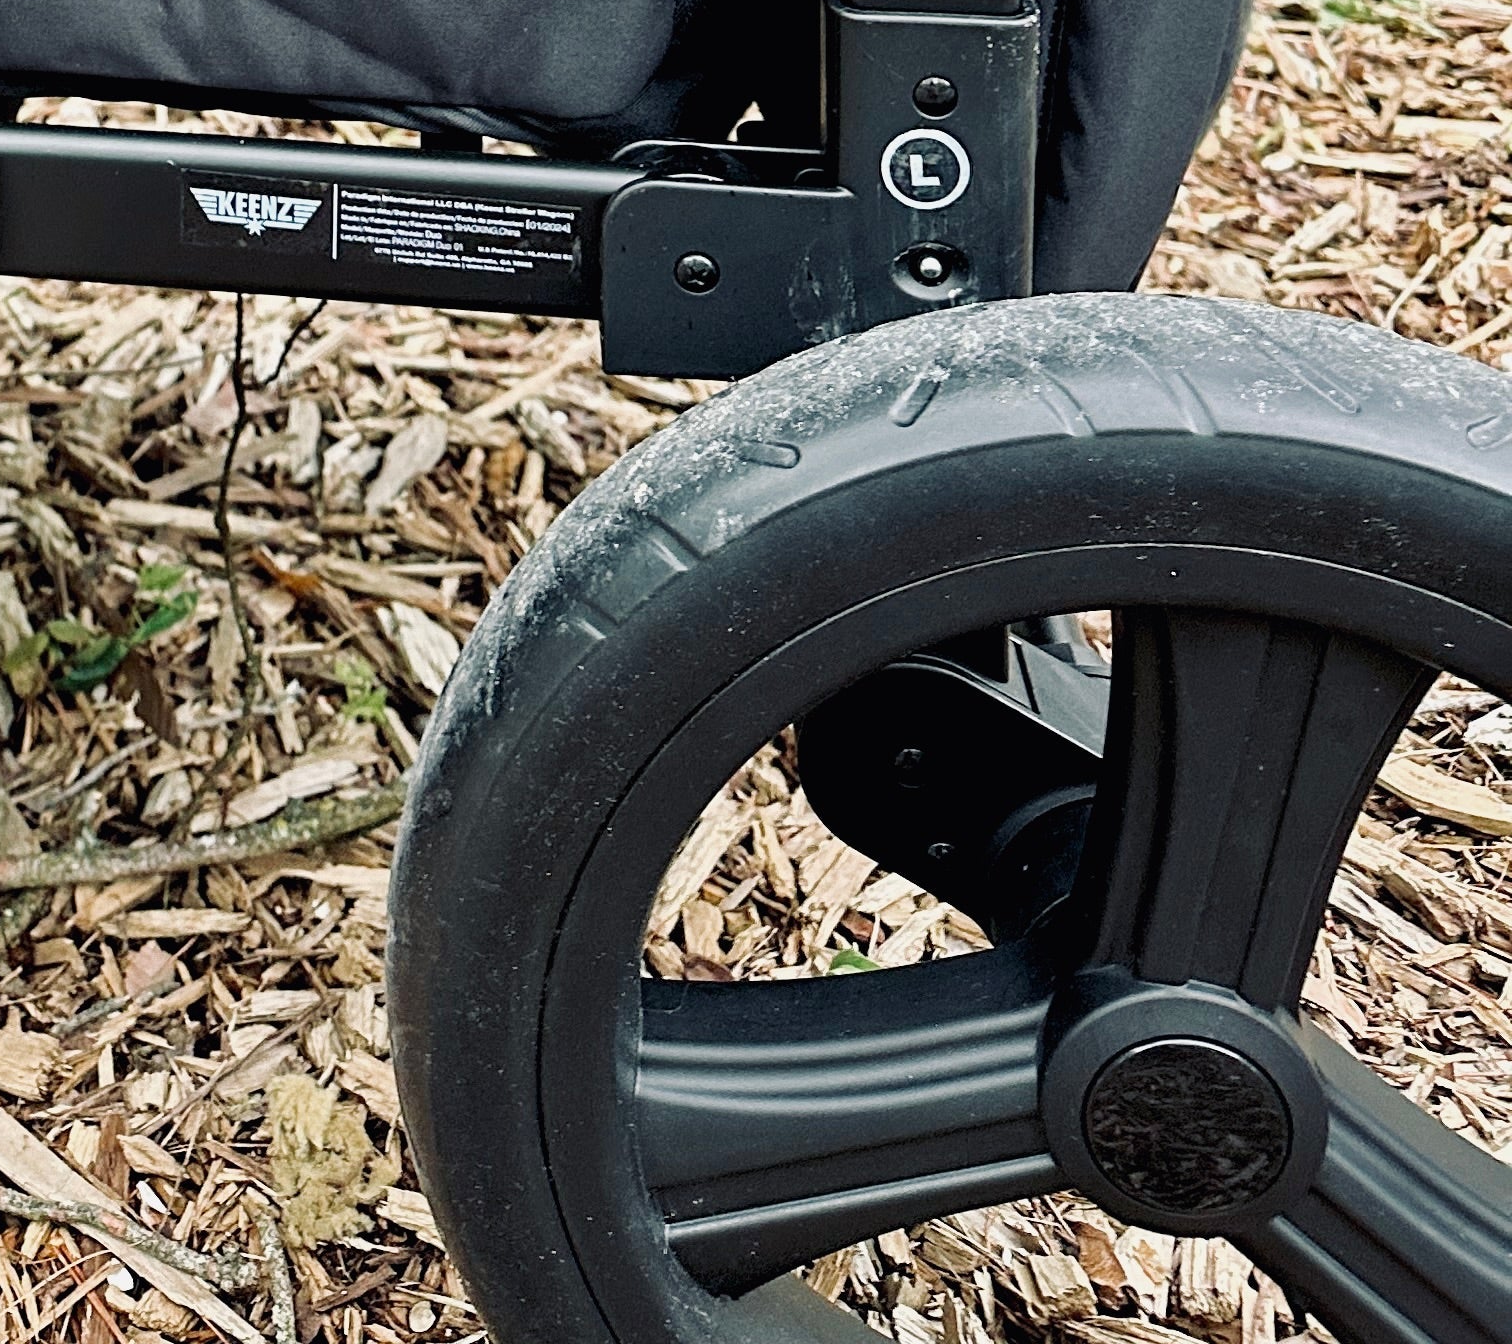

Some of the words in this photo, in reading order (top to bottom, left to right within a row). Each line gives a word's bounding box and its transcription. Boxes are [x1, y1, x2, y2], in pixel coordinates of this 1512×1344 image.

[909, 154, 941, 187] L
[217, 191, 296, 220] KEENZ
[526, 219, 571, 233] [01/2024]
[392, 236, 435, 248] PARADIGM
